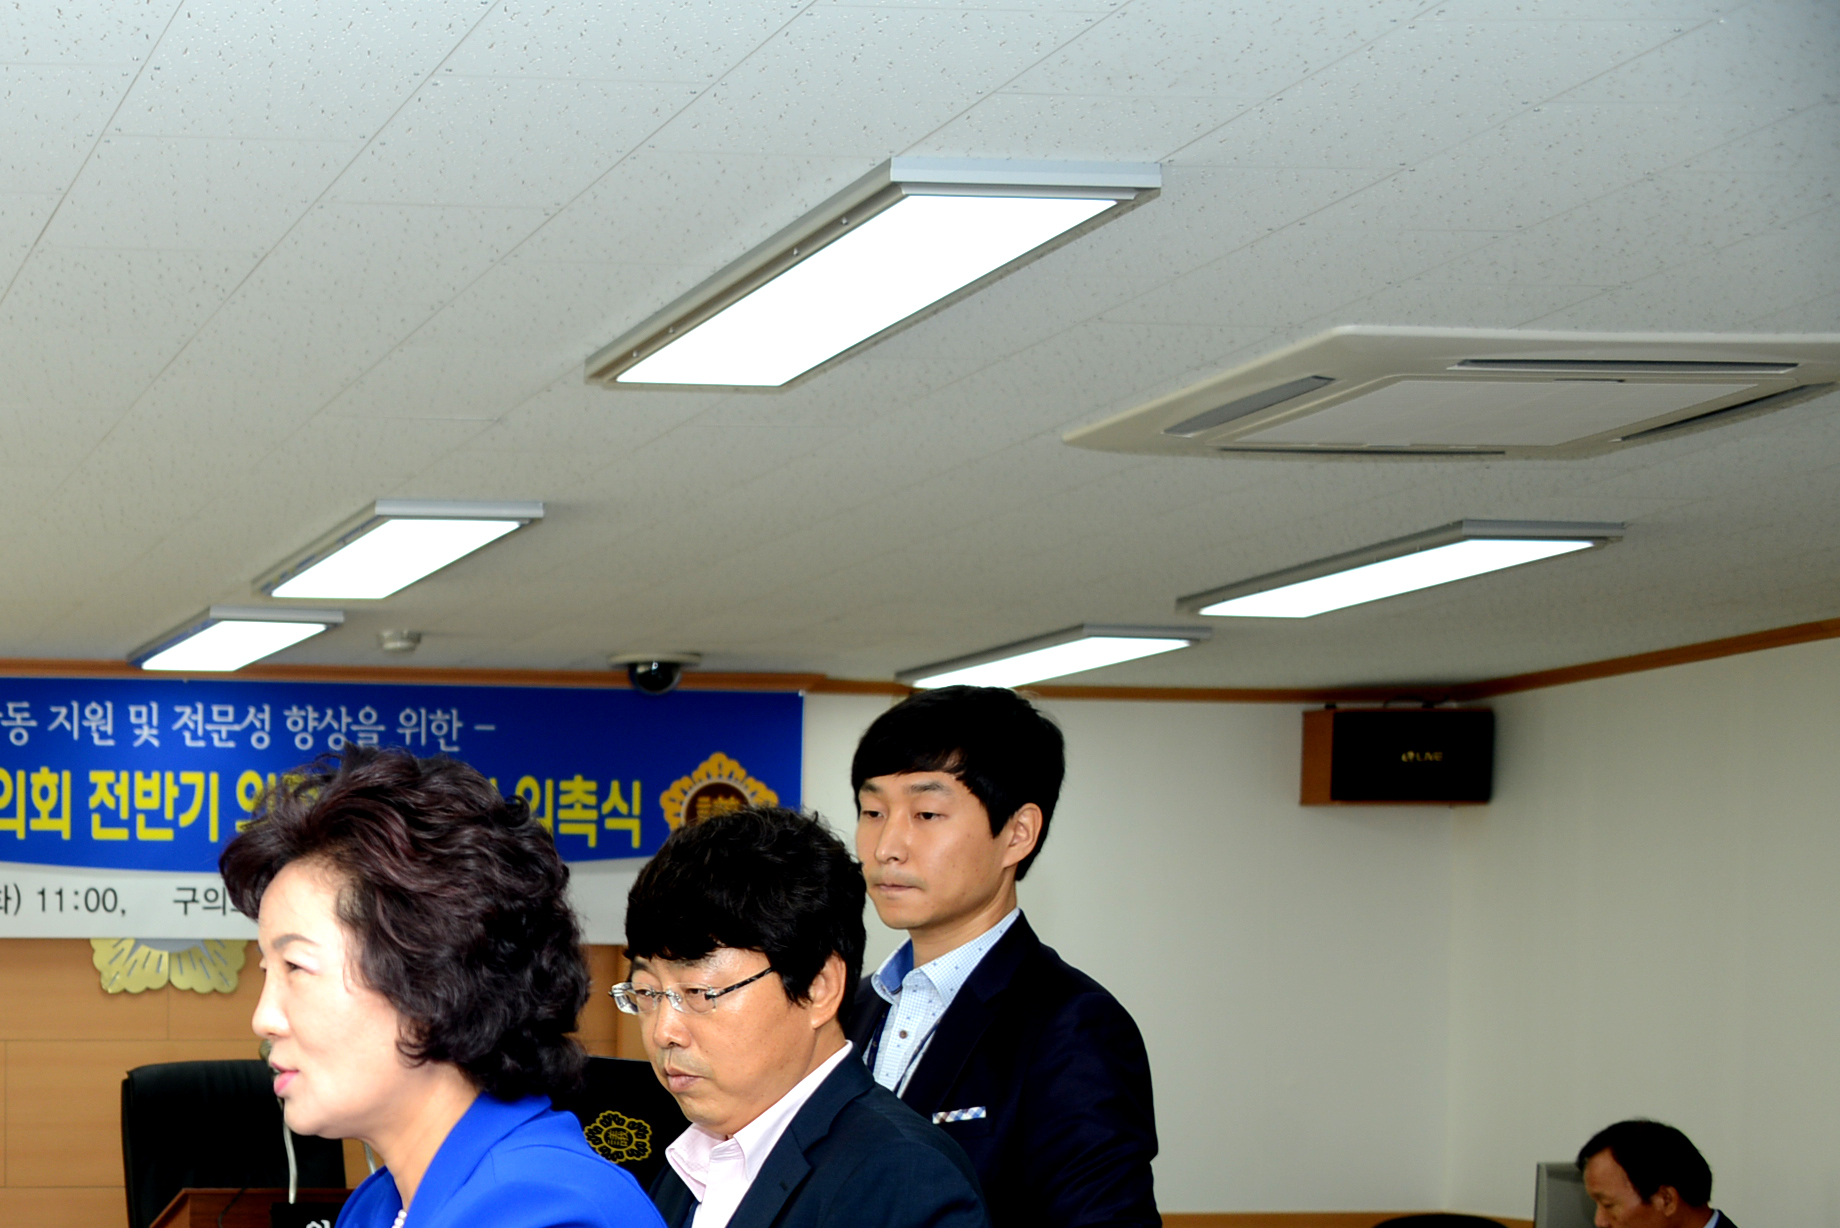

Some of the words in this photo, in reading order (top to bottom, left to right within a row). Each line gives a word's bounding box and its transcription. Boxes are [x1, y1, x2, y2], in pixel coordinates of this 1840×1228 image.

[48, 701, 116, 747] 지원
[128, 701, 160, 748] 및
[171, 702, 271, 750] 전문성
[284, 704, 385, 751] 향상을
[397, 707, 462, 752] 위한
[89, 770, 219, 842] 전반기
[38, 887, 127, 917] 11:00,
[172, 886, 241, 916] 구의
